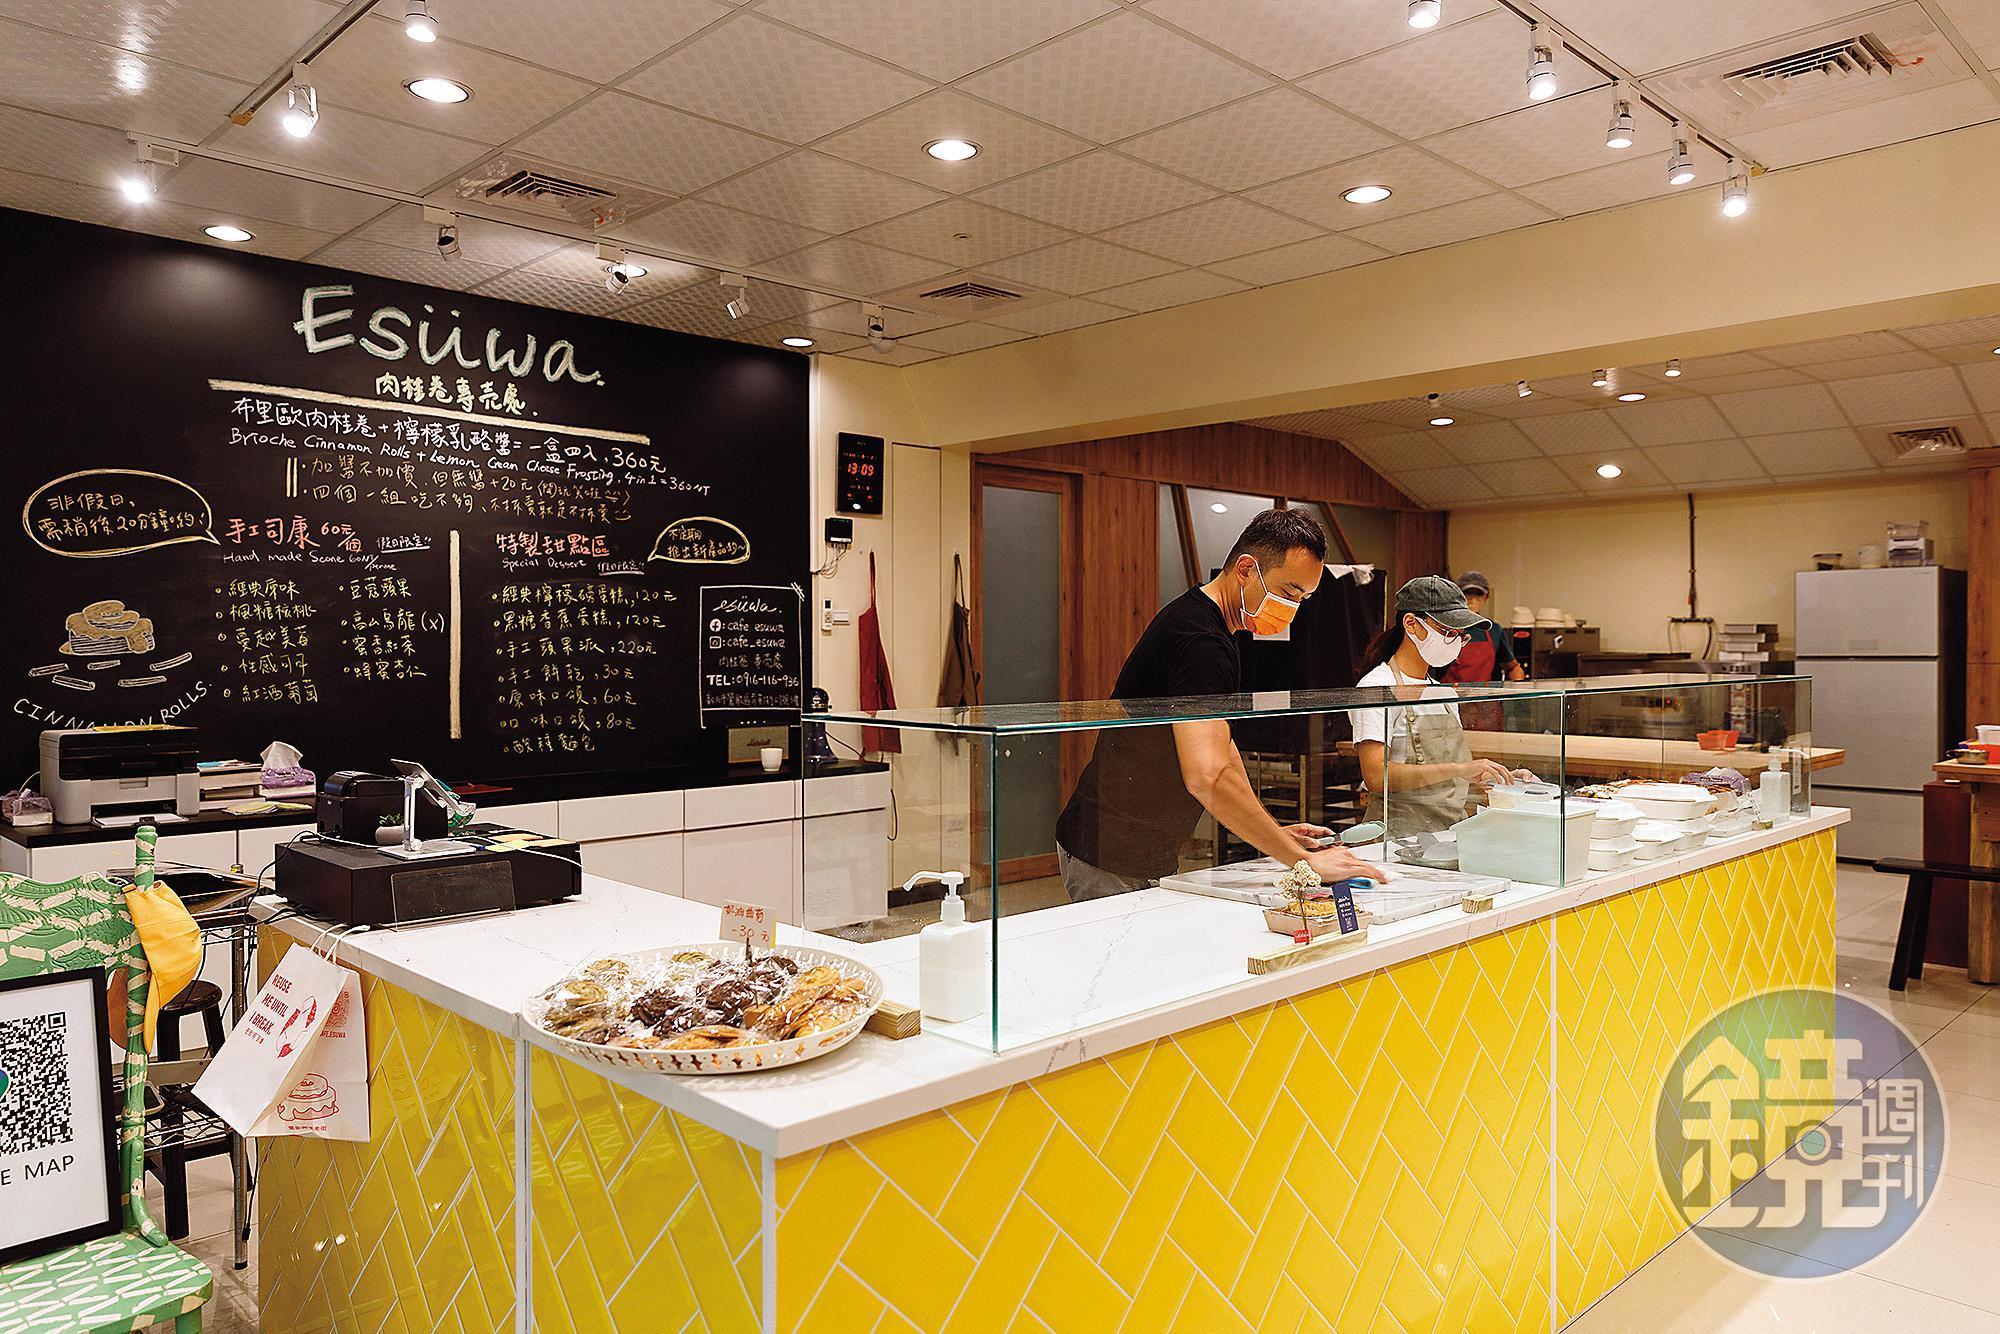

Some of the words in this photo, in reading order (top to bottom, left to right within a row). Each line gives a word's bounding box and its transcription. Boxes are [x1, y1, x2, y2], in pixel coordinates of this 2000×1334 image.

[229, 428, 296, 448] Brioche
[304, 434, 373, 454] Cinnamon
[380, 443, 410, 459] Rolls
[430, 452, 479, 468] Lemon
[224, 515, 320, 550] 手工司康
[495, 531, 610, 557] 特製甜點區
[223, 551, 260, 563] Hand
[268, 551, 302, 562] made
[502, 558, 539, 572] Special
[548, 558, 587, 568] Dessert
[228, 578, 300, 600] 經典原味
[229, 601, 317, 623] 楓糖核桃
[352, 608, 416, 631] 高山烏龍
[754, 624, 785, 633] esuwa
[352, 634, 416, 656] 蜜香紅茶
[353, 658, 427, 681] 蜂蜜杏仁
[241, 679, 318, 704] 紅酒葡萄
[272, 974, 292, 993] REUSE
[261, 993, 274, 1007] ME
[271, 998, 289, 1017] UNTIL
[24, 1154, 75, 1181] MAP
